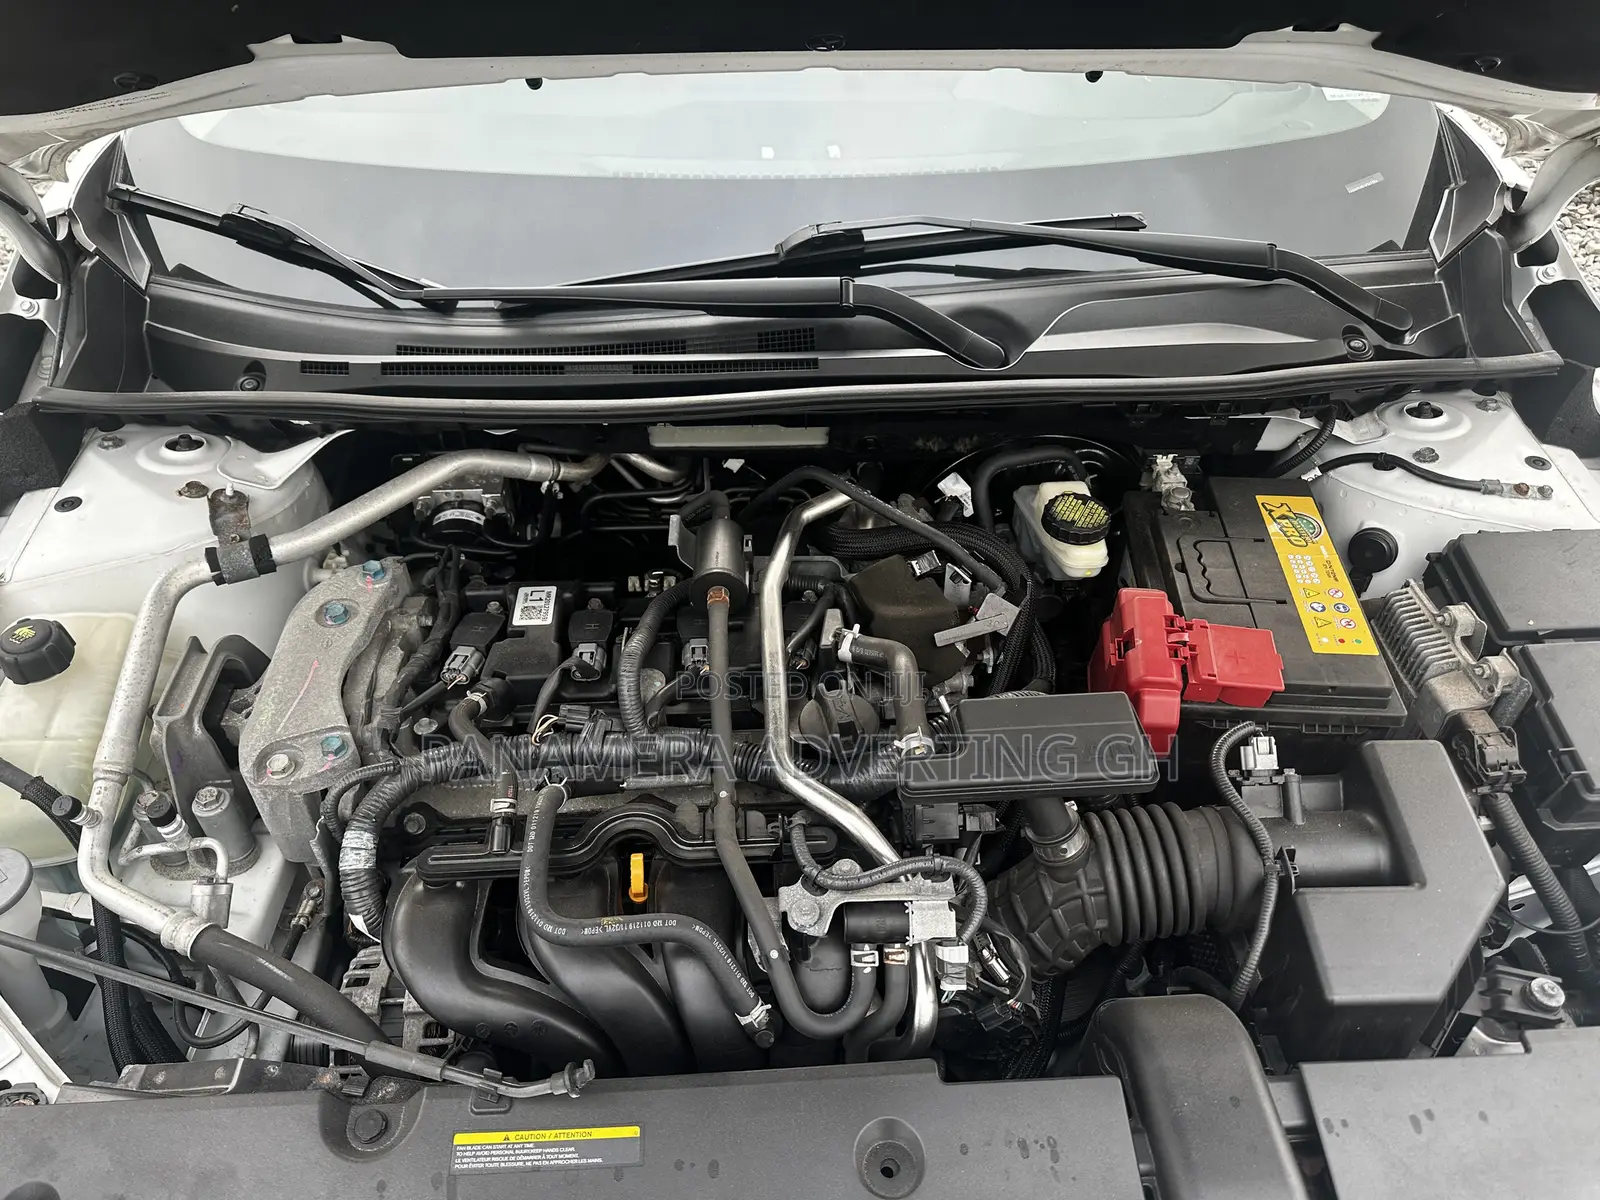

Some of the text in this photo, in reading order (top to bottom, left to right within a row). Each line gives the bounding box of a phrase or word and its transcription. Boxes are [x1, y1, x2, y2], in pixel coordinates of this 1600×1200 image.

[529, 590, 545, 602] L1
[629, 921, 651, 930] 011219
[554, 927, 566, 935] DOT
[726, 958, 741, 978] 011219
